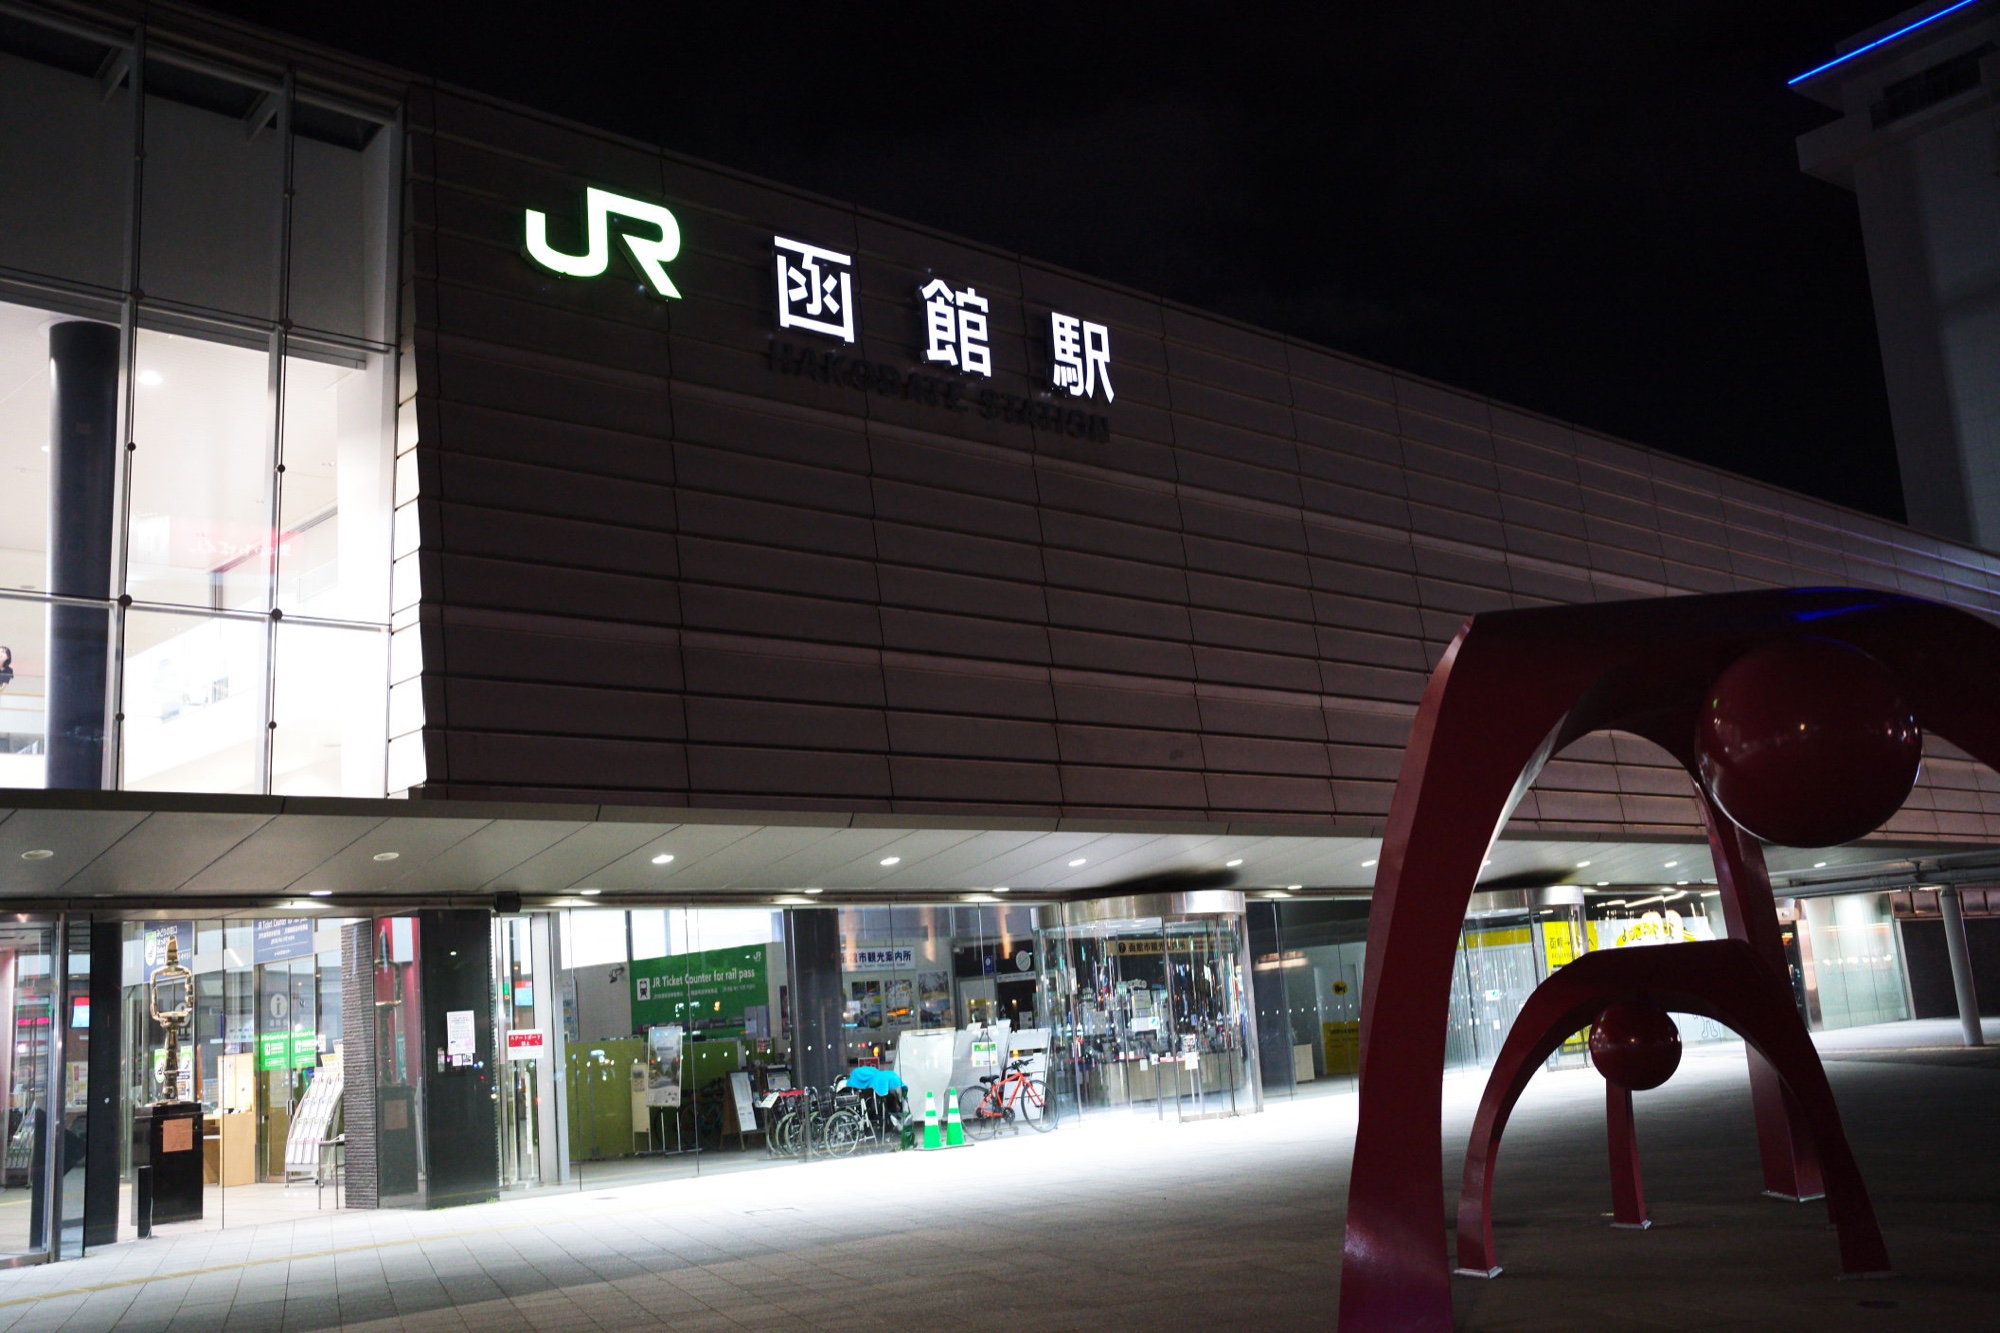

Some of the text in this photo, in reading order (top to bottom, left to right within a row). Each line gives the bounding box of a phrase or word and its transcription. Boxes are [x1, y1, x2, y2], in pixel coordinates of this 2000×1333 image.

[525, 186, 682, 299] JR
[774, 235, 1115, 403] 函館駅
[768, 339, 1111, 444] HAKODATE STATION
[652, 968, 755, 988] JR Ticket Counter for rail pass
